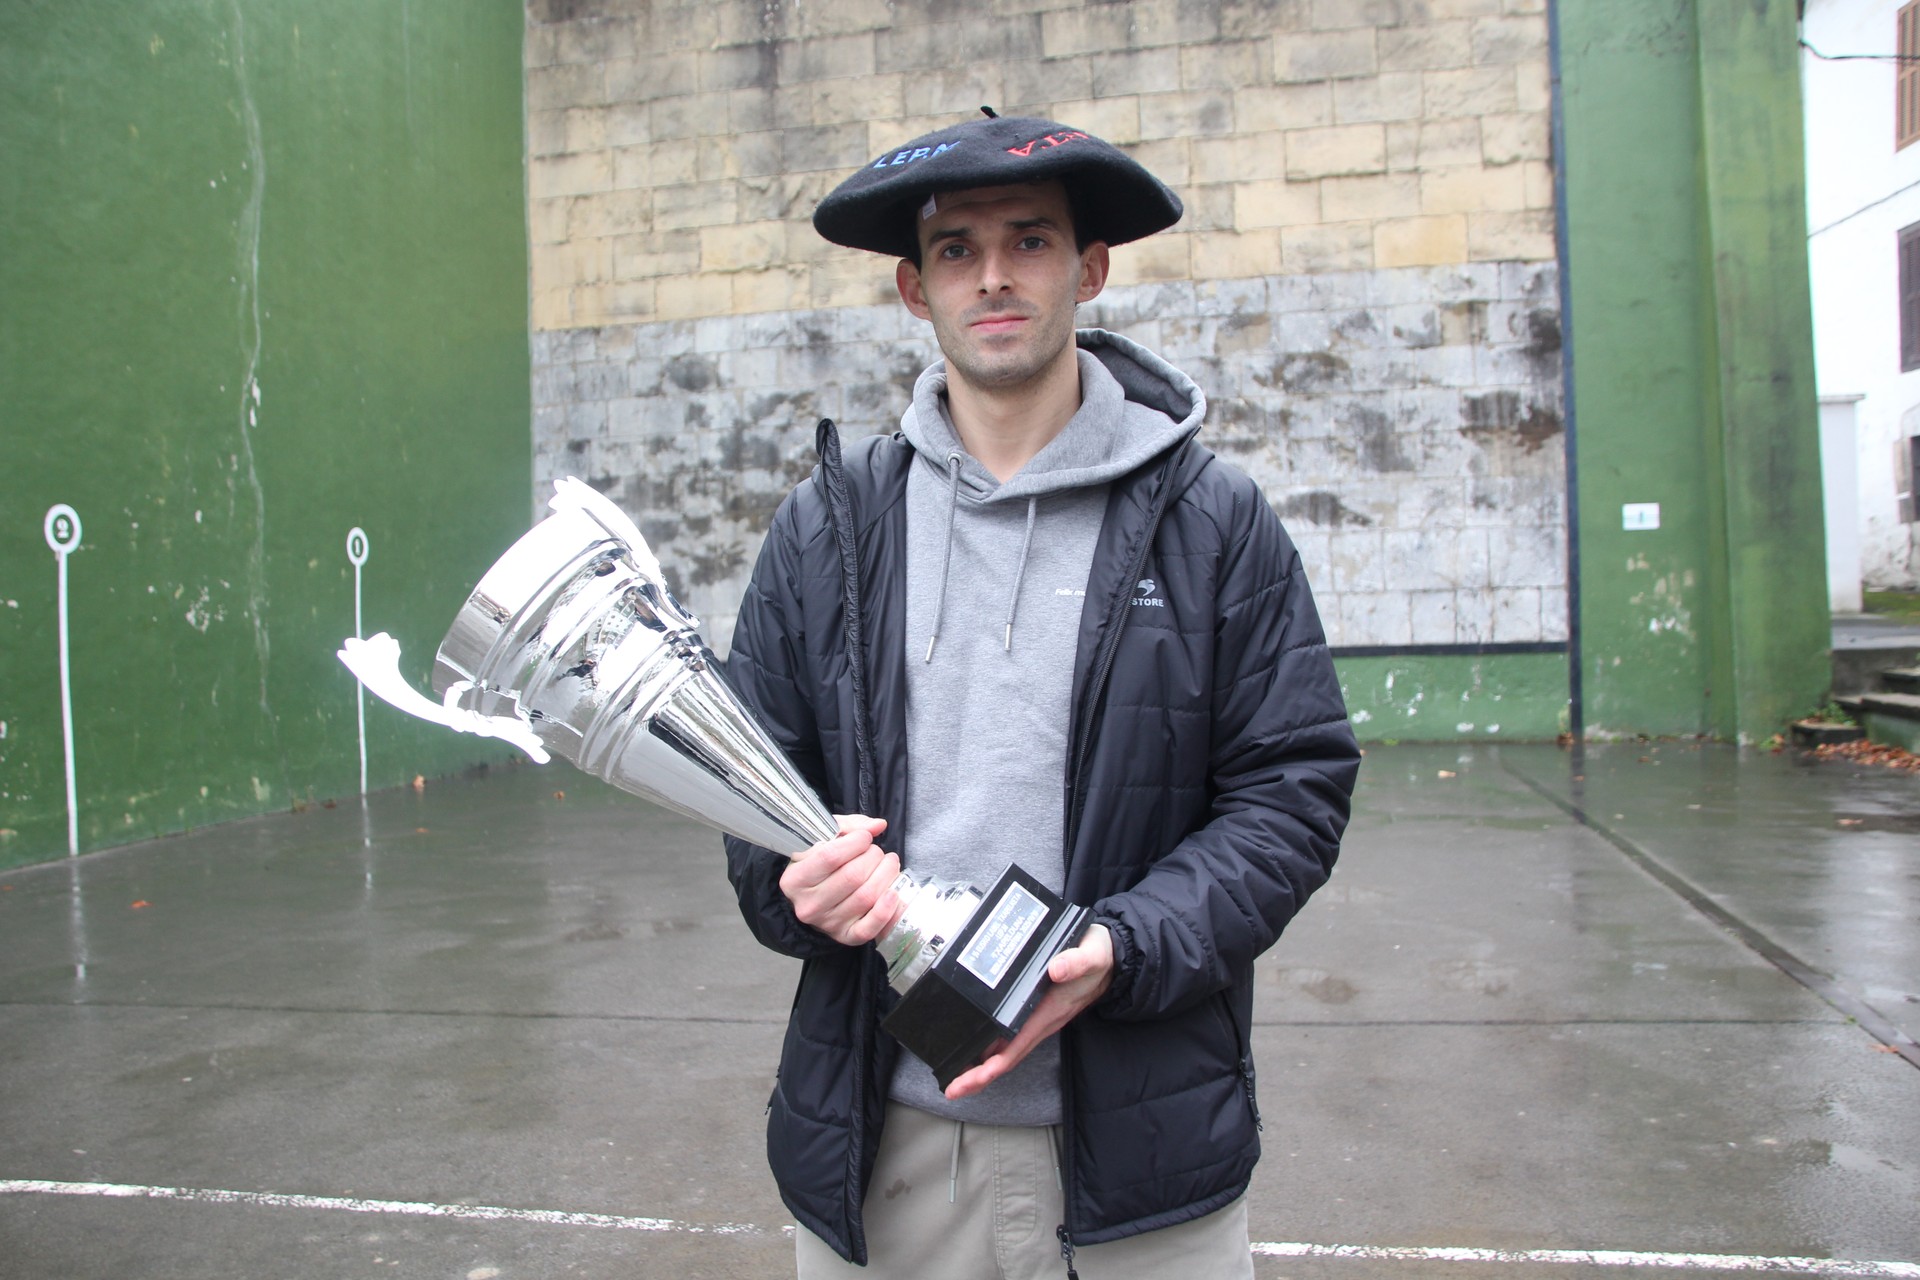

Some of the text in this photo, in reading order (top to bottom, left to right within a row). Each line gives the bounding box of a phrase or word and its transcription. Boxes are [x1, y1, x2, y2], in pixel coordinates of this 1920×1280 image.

[56, 518, 69, 538] 2
[354, 538, 361, 556] 1
[1132, 597, 1164, 608] STORE
[990, 915, 1025, 958] TXAPELDUNA
